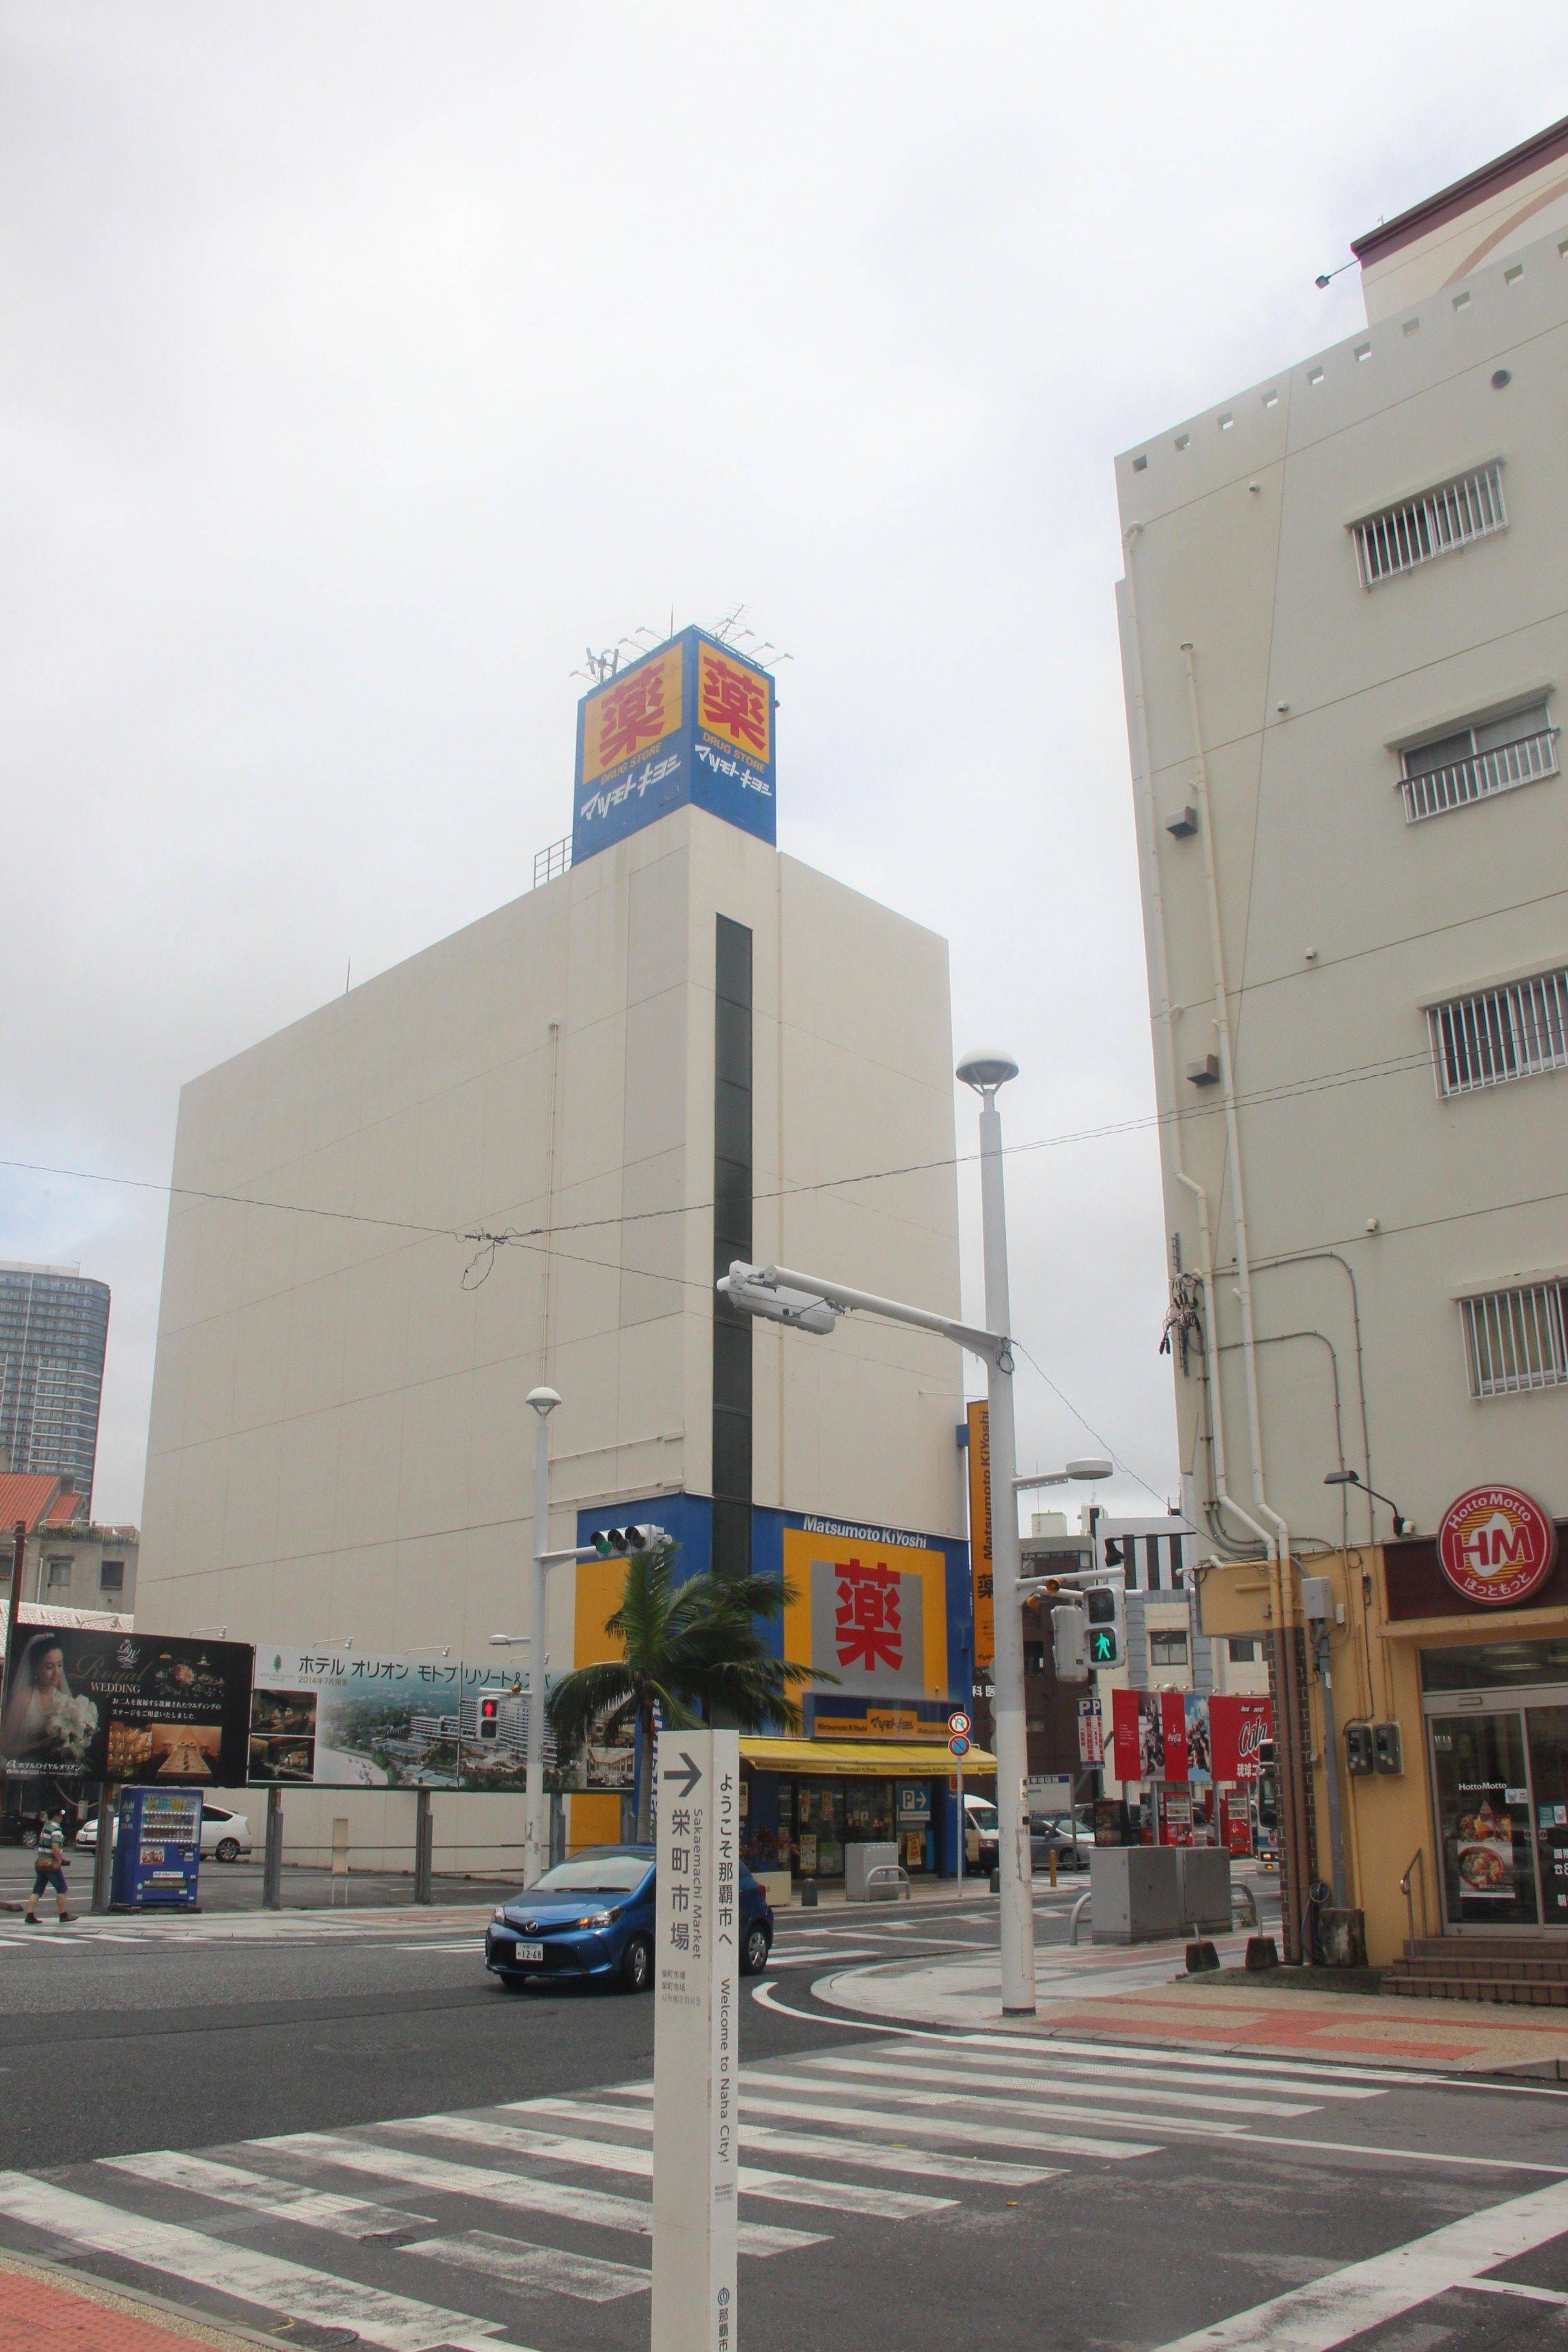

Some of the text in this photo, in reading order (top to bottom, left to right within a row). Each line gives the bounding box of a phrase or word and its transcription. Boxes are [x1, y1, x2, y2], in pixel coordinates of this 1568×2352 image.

[599, 662, 665, 766] 薬
[704, 656, 766, 751] 薬
[601, 742, 662, 785] DRUG STORE
[702, 732, 765, 773] DRUG STORE
[803, 1516, 927, 1550] Matsumoto KiYoshi
[1452, 1524, 1534, 1570] HM
[1465, 1572, 1531, 1596] ほっともっと
[834, 1558, 904, 1671] 薬
[91, 1682, 141, 1694] WEDDING
[299, 1656, 345, 1676] ホテル
[351, 1660, 408, 1680] オリオン
[418, 1665, 458, 1683] モトブ
[670, 1808, 691, 1950] 栄町市場
[719, 1774, 733, 1945] ようこそ那覇市へ
[693, 1808, 703, 1959] Sakaemachi Market
[718, 1978, 730, 2163] Welcome to Naha City!
[719, 2308, 728, 2352] 那覇市
